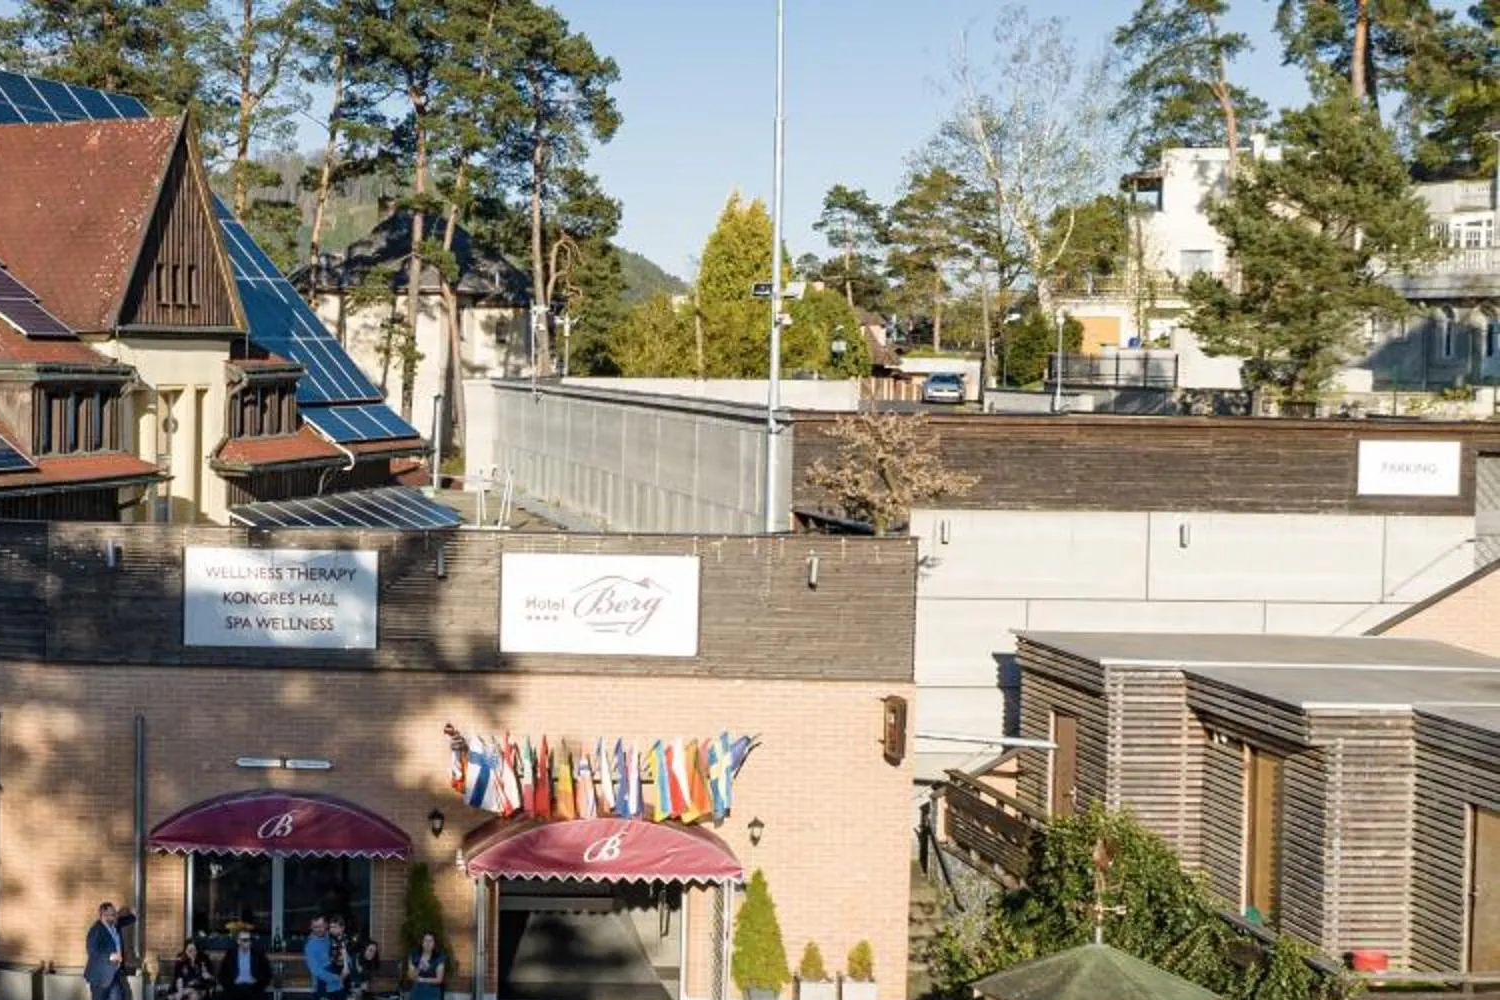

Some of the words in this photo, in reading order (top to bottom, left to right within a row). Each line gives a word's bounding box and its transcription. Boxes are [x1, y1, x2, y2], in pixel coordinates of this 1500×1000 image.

[1381, 462, 1438, 475] PARKING
[206, 566, 283, 581] WELLNESS
[287, 567, 357, 582] THERAPY
[223, 591, 295, 606] KONGRES
[299, 591, 338, 606] HALL
[525, 597, 565, 611] Hotel
[225, 615, 252, 630] SPA
[255, 617, 334, 631] WELLNESS
